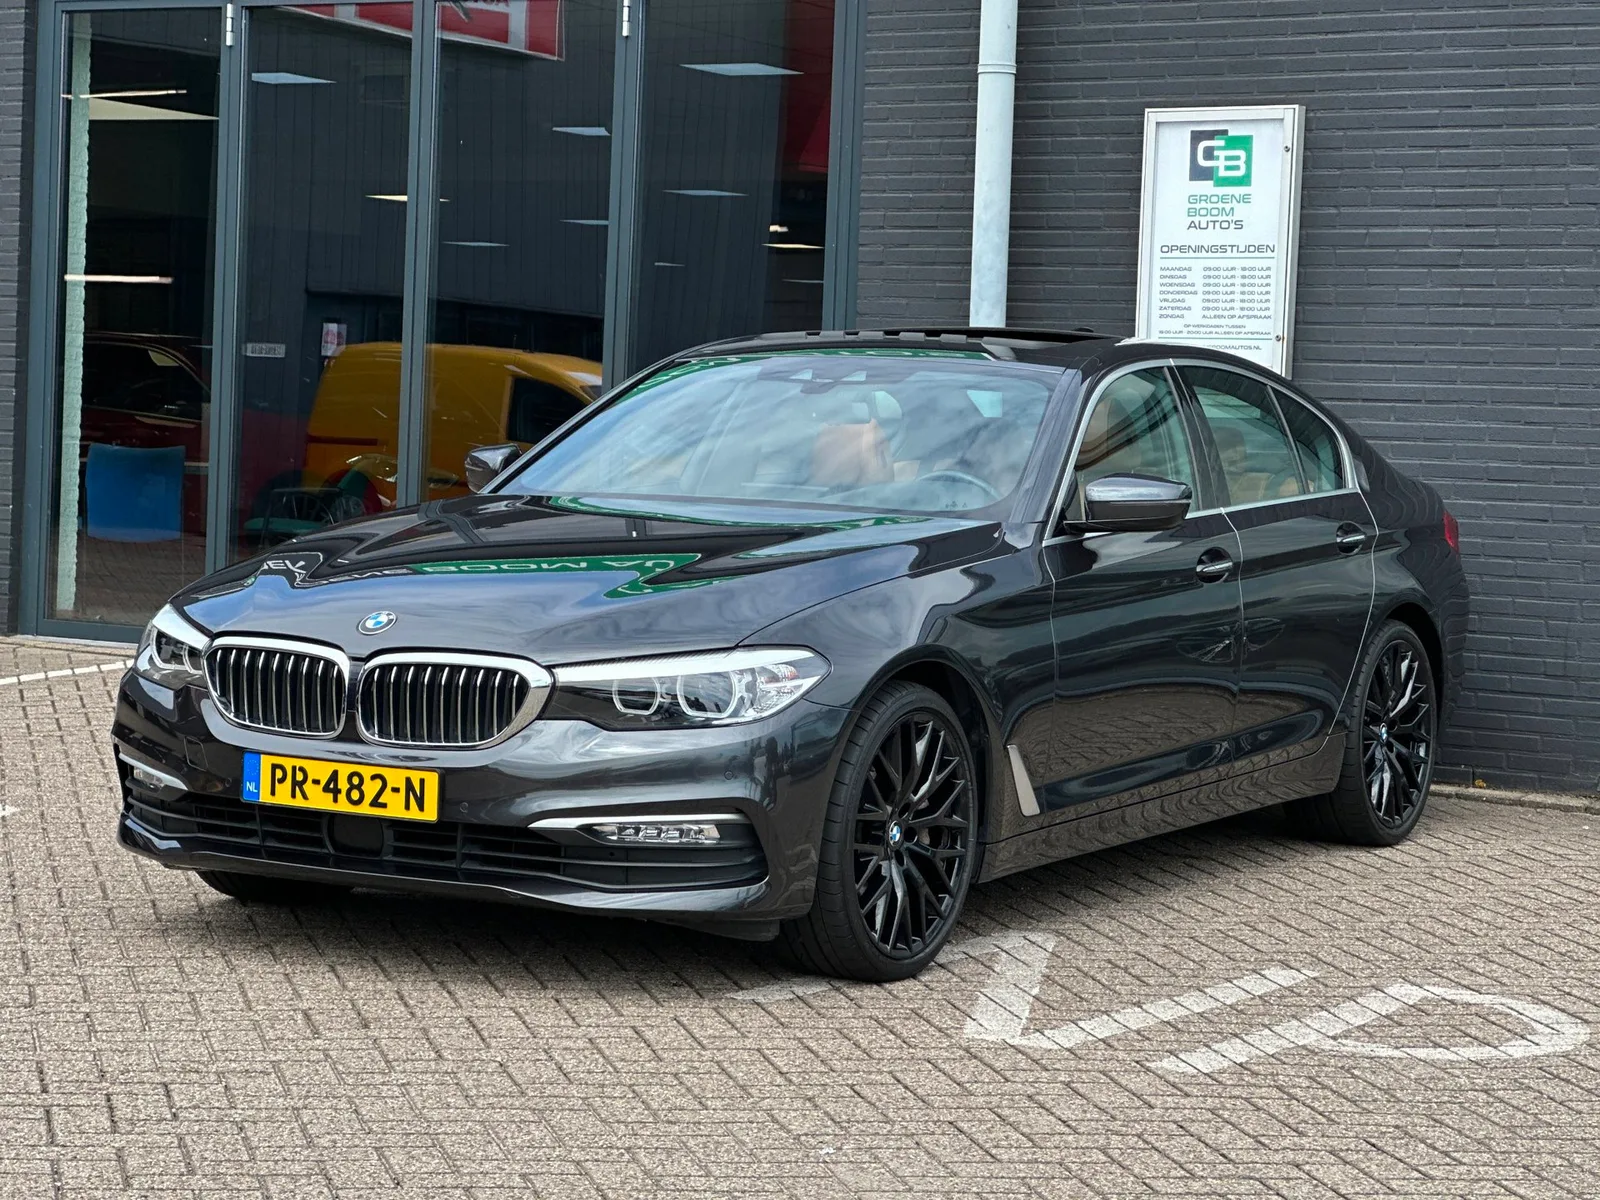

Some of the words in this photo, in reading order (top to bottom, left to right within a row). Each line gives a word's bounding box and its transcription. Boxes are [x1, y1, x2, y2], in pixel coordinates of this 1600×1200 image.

[1187, 193, 1252, 204] GROENE
[1187, 207, 1235, 217] BOOM
[1187, 219, 1244, 230] AUTO'S
[1160, 244, 1276, 254] OPENINGSTIJDEN
[246, 781, 258, 793] NL
[270, 763, 426, 813] PR-482-N
